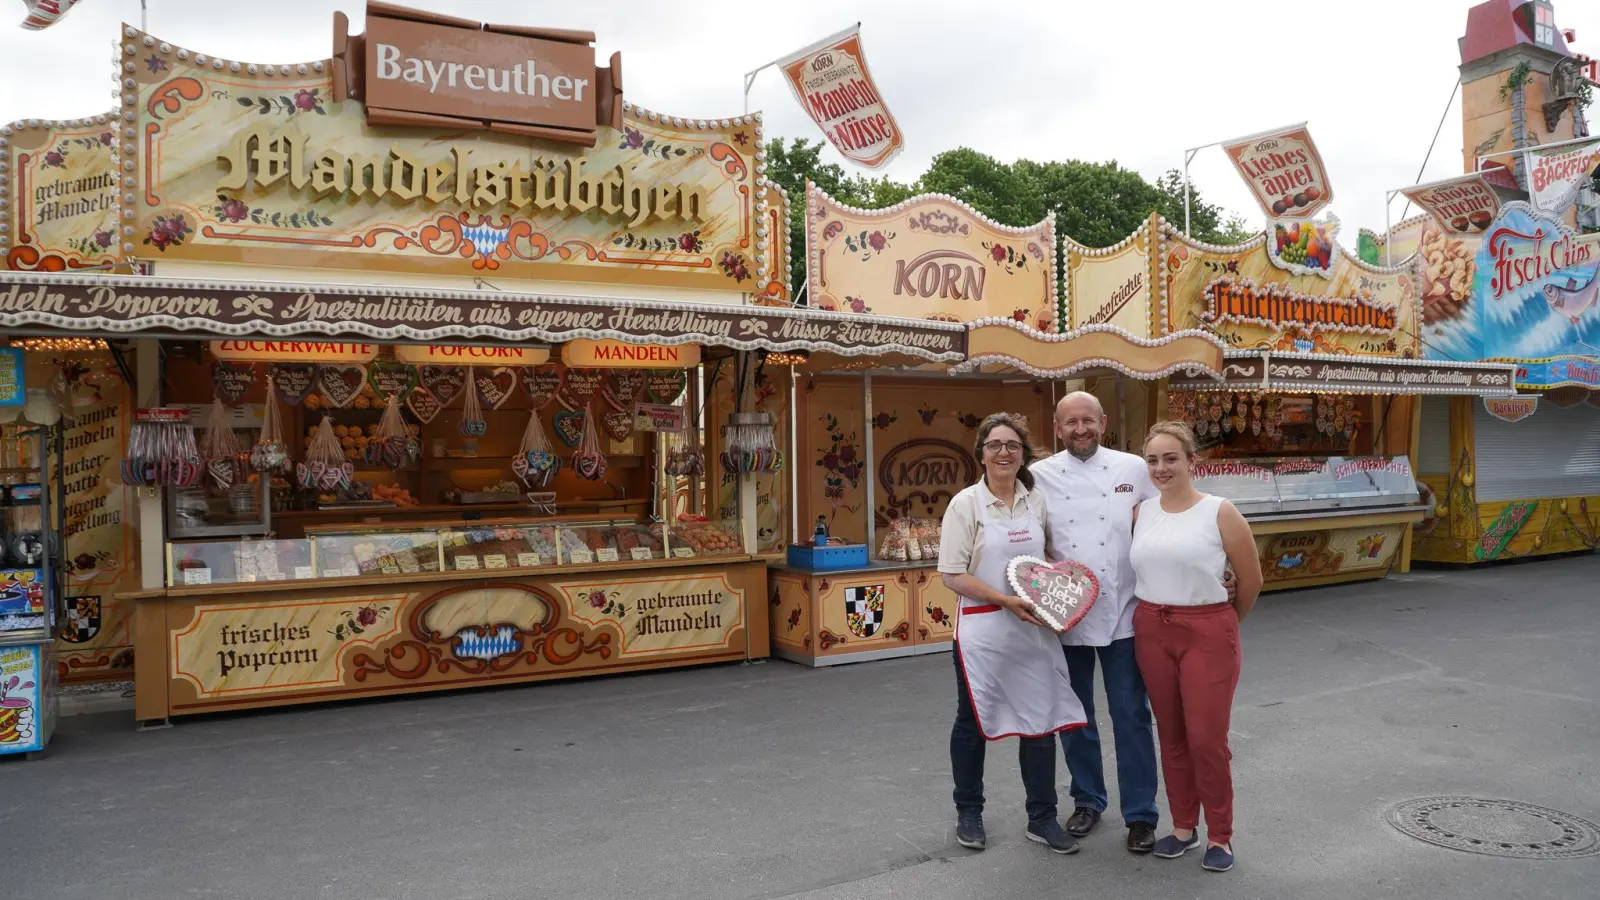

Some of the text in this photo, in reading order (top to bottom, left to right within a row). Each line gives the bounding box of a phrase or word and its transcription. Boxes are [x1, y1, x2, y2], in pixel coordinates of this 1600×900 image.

[376, 43, 588, 102] Bayreuther
[811, 53, 834, 73] KORN
[808, 78, 878, 122] Mandeln
[834, 113, 891, 151] Nüsse
[1254, 140, 1279, 153] KORN
[1240, 148, 1308, 179] Liebes
[1531, 155, 1591, 192] BACKFIS
[36, 171, 116, 204] gebrannte
[216, 130, 710, 229] Mandelstübchen
[893, 249, 986, 301] KORN
[1489, 228, 1550, 298] Fisch
[1550, 234, 1592, 270] Chips
[281, 293, 464, 324] Spezialitäten
[515, 305, 603, 331] eigener
[220, 340, 371, 354] ZUCKERWATTE
[429, 345, 523, 358] POPCORN
[594, 345, 678, 361] MANDELN
[1317, 364, 1379, 382] Spezialitäten
[1397, 369, 1427, 385] eigener
[45, 405, 118, 439] grannte
[898, 453, 959, 486] KORN
[1191, 461, 1270, 482] HOKOFRÜCHTE
[1334, 459, 1409, 480] SCHOKOFRÜCHTE
[1114, 484, 1133, 493] KORN
[1280, 535, 1316, 549] KORN
[1055, 574, 1083, 597] Ich
[636, 589, 723, 615] gebrannte
[1041, 592, 1068, 619] Dich
[220, 622, 310, 646] frisches
[635, 611, 722, 636] Mandeln
[216, 648, 319, 677] Popcorn
